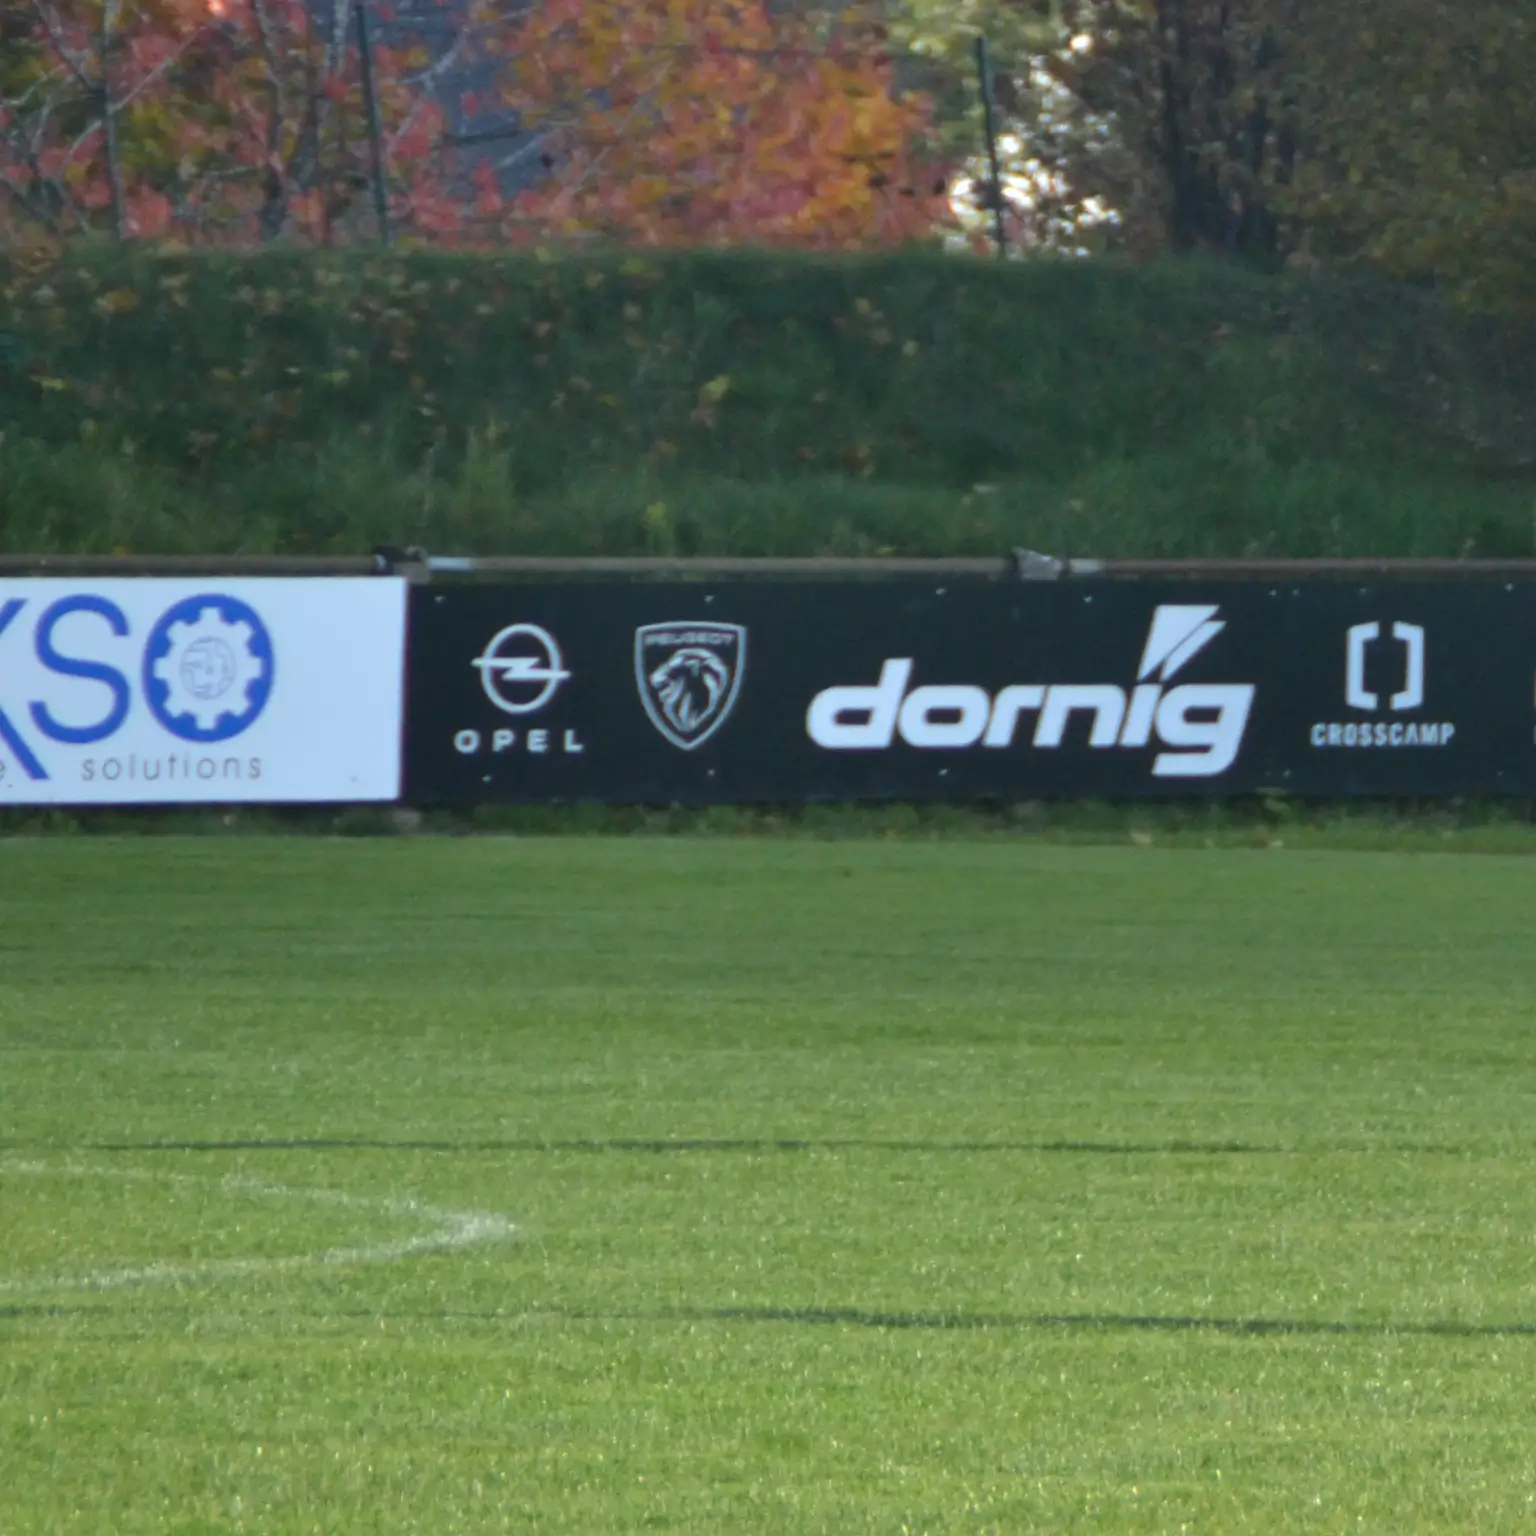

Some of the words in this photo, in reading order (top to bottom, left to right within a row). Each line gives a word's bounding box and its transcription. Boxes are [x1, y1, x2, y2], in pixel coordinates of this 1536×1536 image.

[806, 604, 1256, 776] dornig
[454, 729, 584, 752] OPEL
[1310, 722, 1456, 747] CROSSCAMP
[81, 752, 263, 781] solutions
